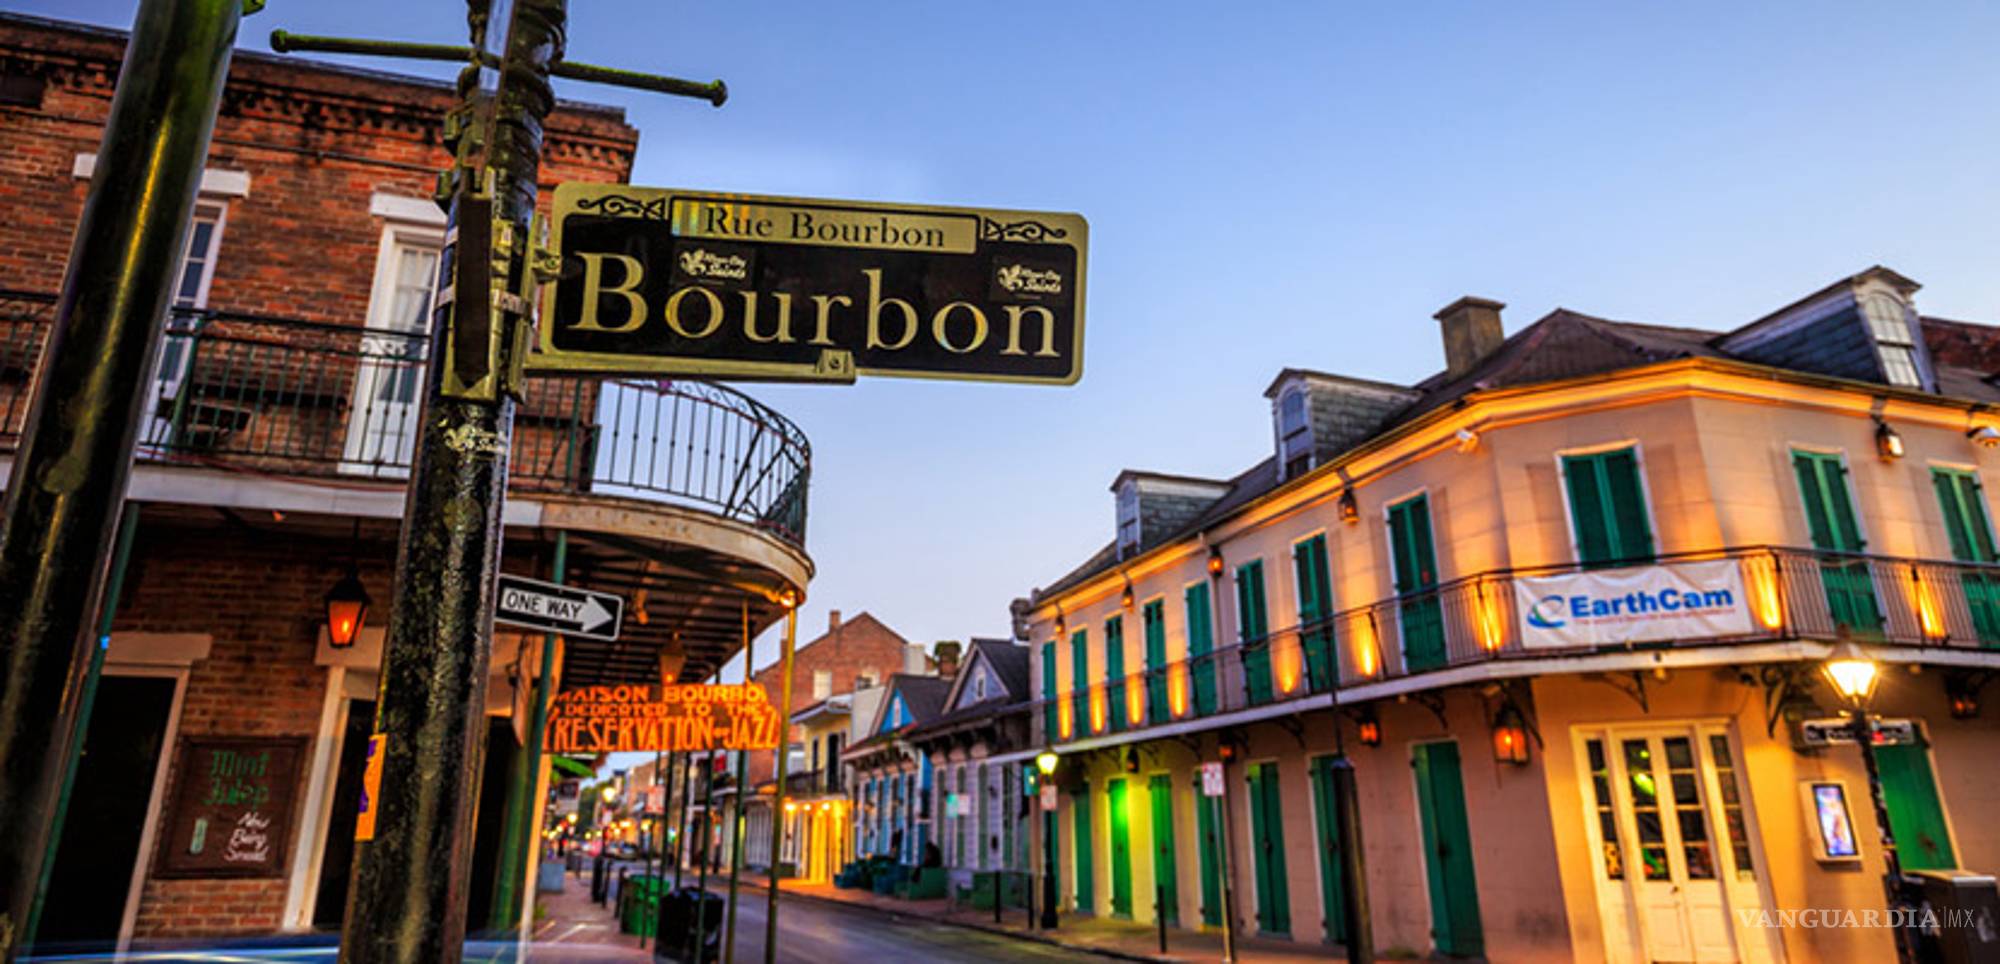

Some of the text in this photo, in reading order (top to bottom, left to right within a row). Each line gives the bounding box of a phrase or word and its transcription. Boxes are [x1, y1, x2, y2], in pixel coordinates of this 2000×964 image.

[705, 207, 945, 248] Rue Bourbon
[567, 252, 1062, 358] Bourbon
[506, 592, 582, 617] ONE WAY
[1570, 588, 1734, 618] EarthCam
[566, 703, 760, 717] DEDICATED TO THE
[723, 707, 778, 750] JAZZ
[211, 751, 270, 776] Mint
